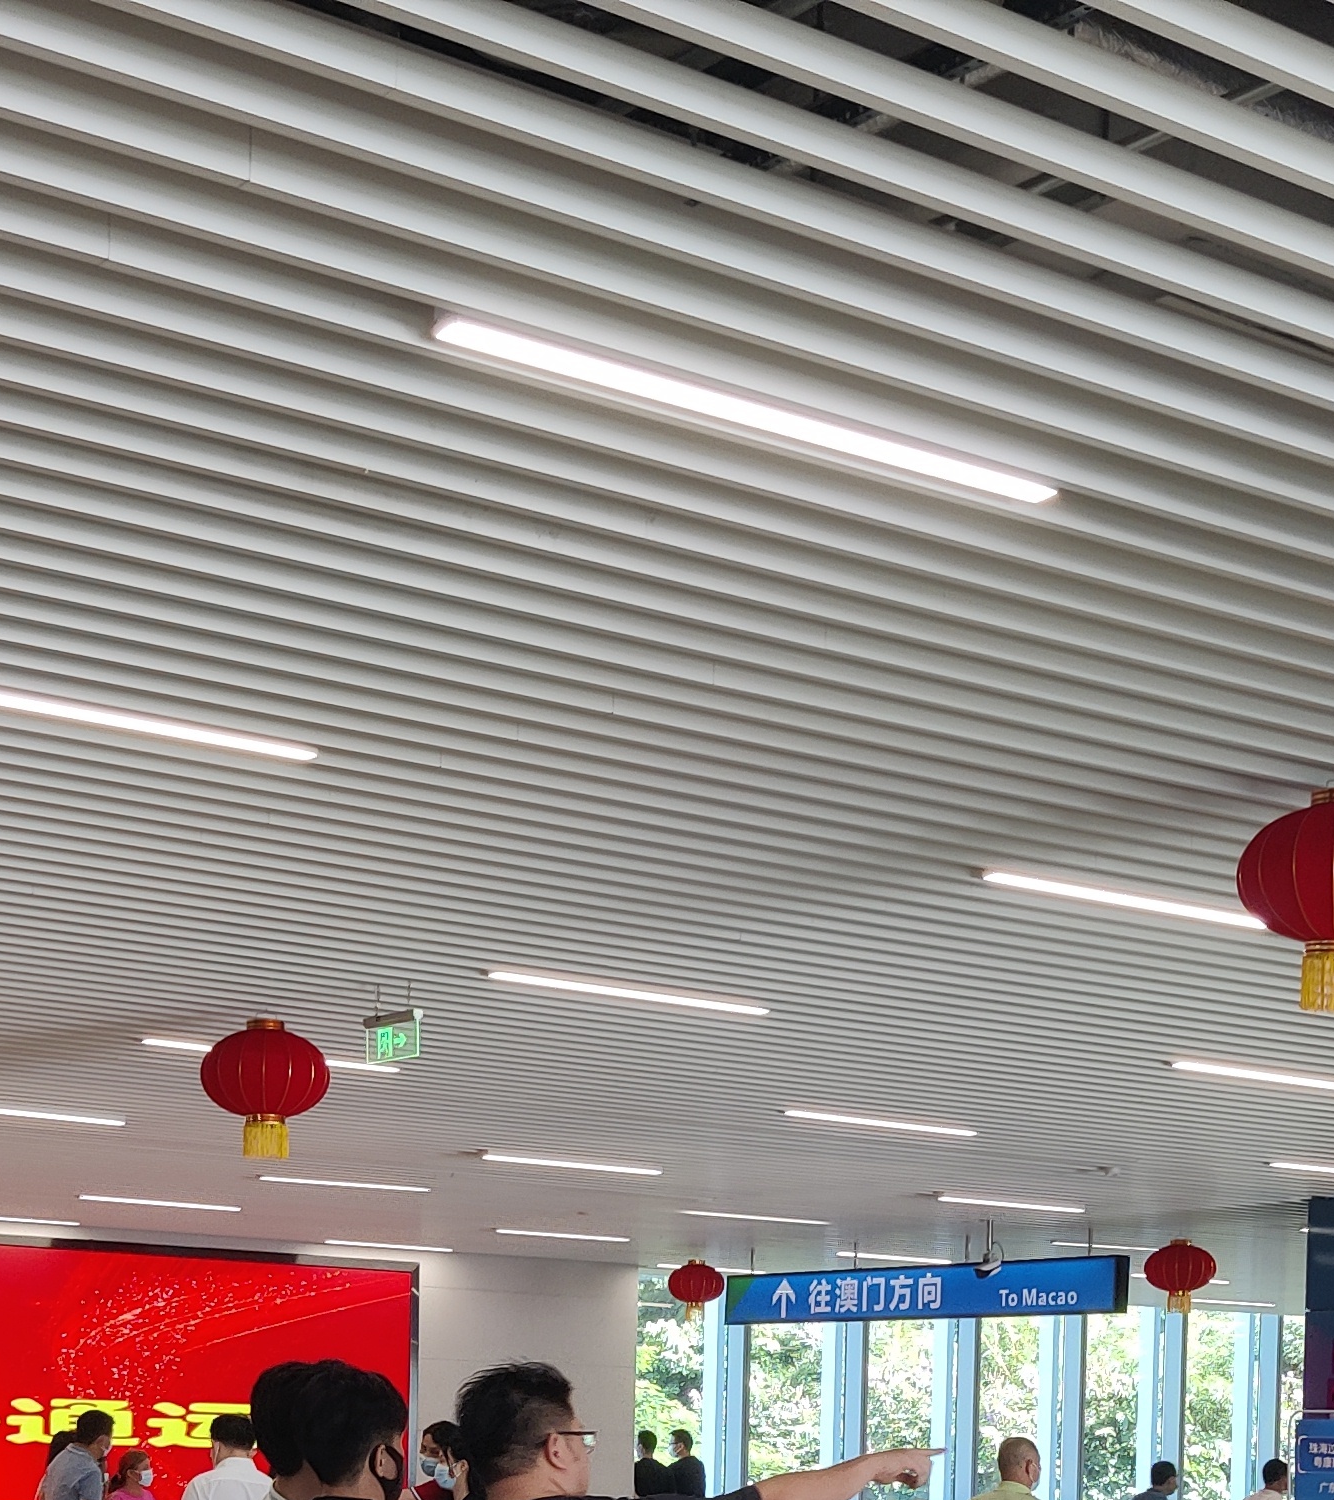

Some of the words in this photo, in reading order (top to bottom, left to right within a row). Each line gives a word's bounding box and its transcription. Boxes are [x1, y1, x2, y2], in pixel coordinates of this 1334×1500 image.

[808, 1272, 942, 1314] 往澳门方向
[999, 1289, 1017, 1308] To
[1022, 1287, 1078, 1307] Macao
